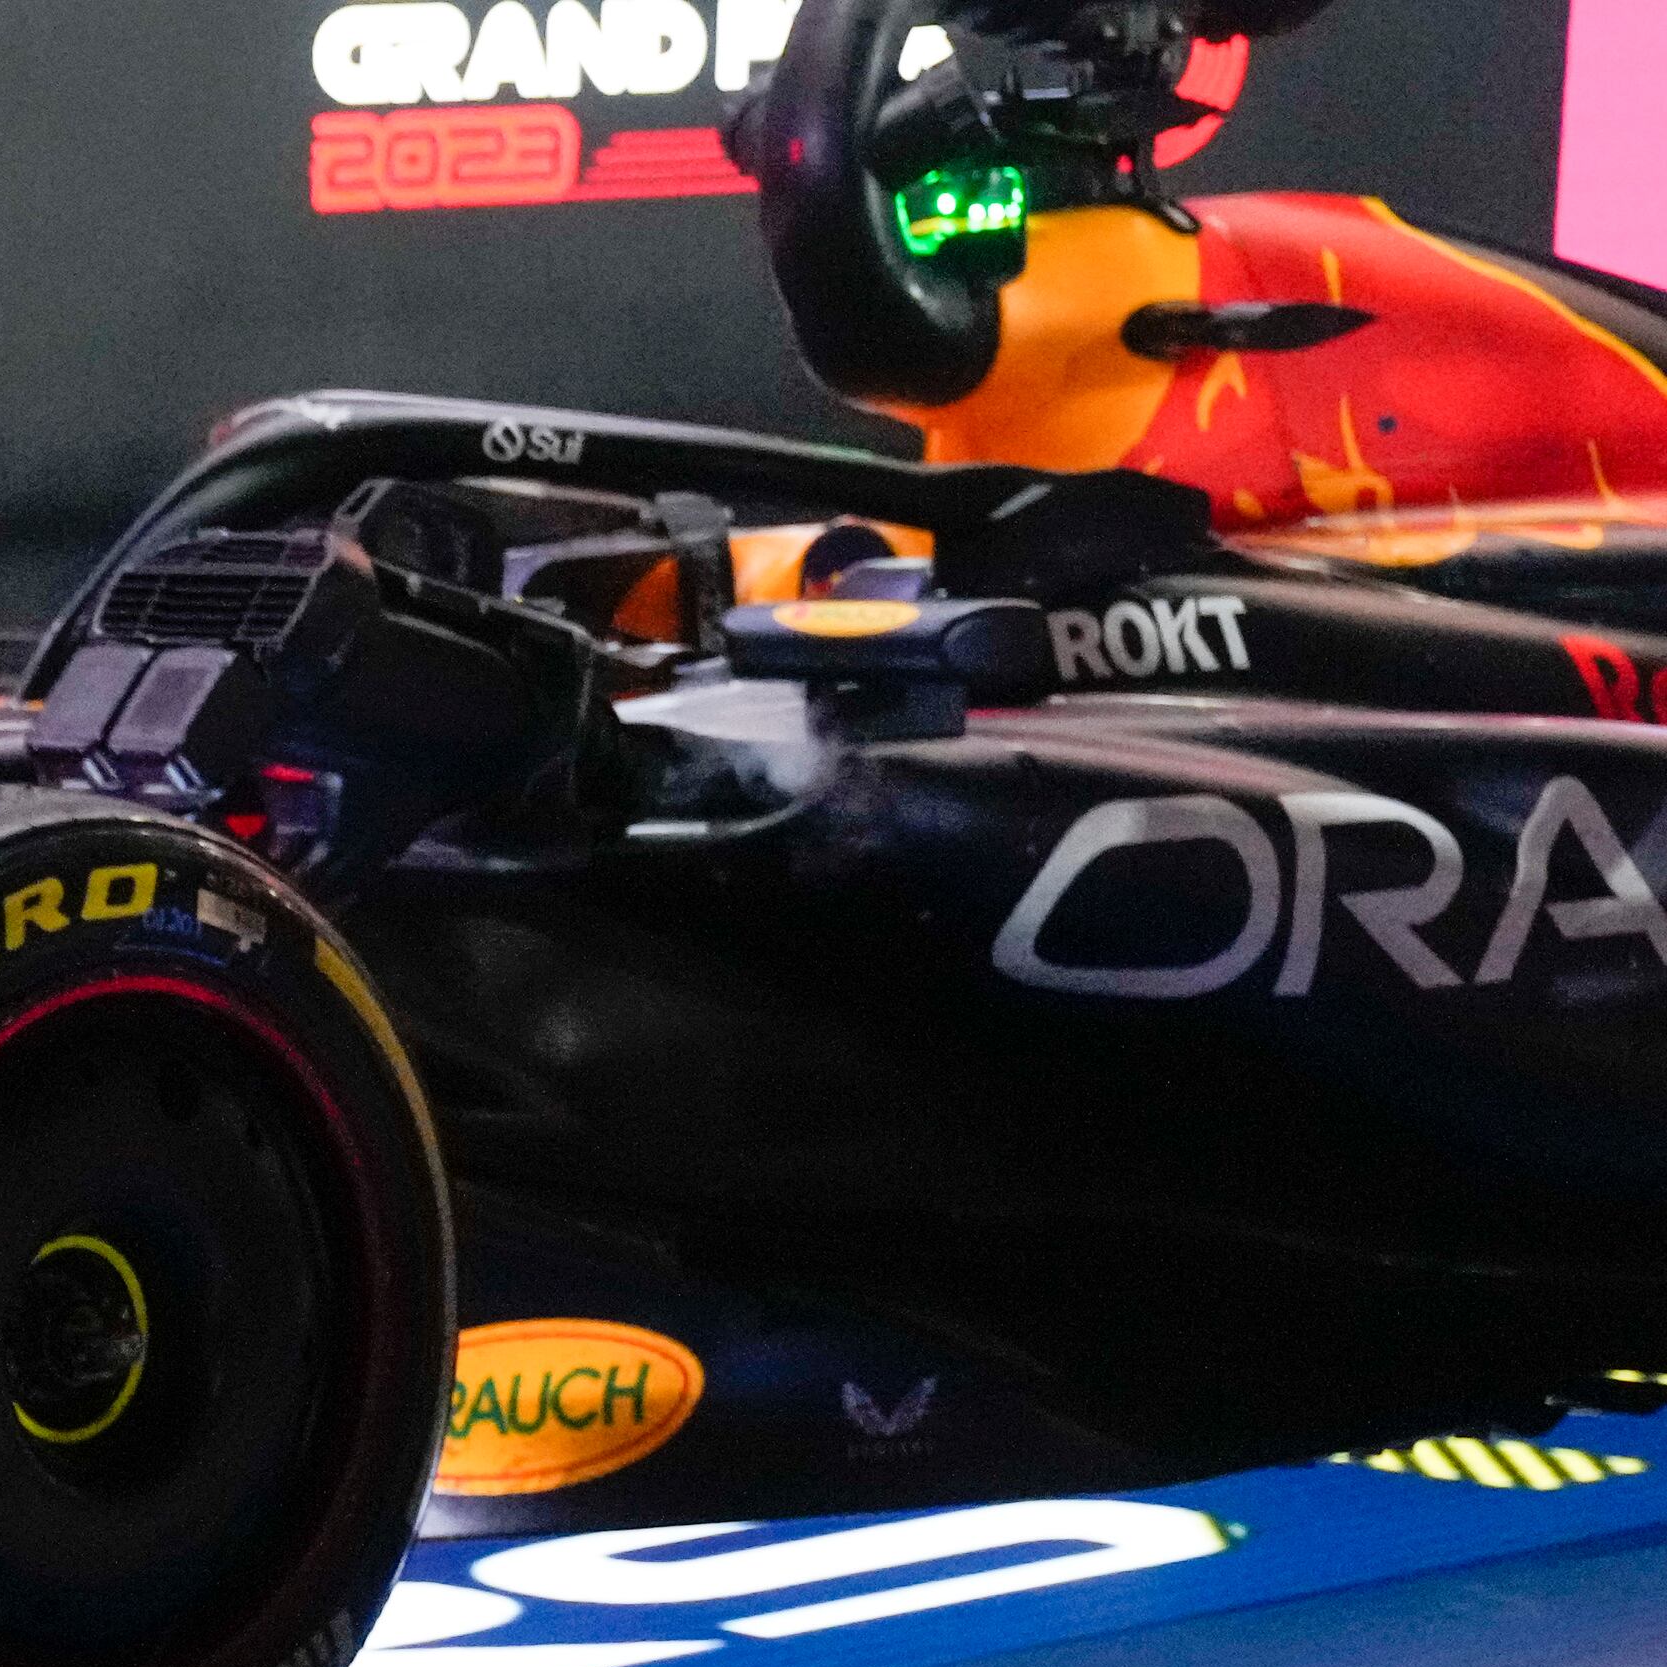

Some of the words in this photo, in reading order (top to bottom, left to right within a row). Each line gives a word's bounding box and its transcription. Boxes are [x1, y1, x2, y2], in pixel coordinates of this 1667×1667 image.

[312, 0, 709, 104] GRAND
[310, 103, 582, 215] 2023
[1047, 594, 1251, 683] ROKT
